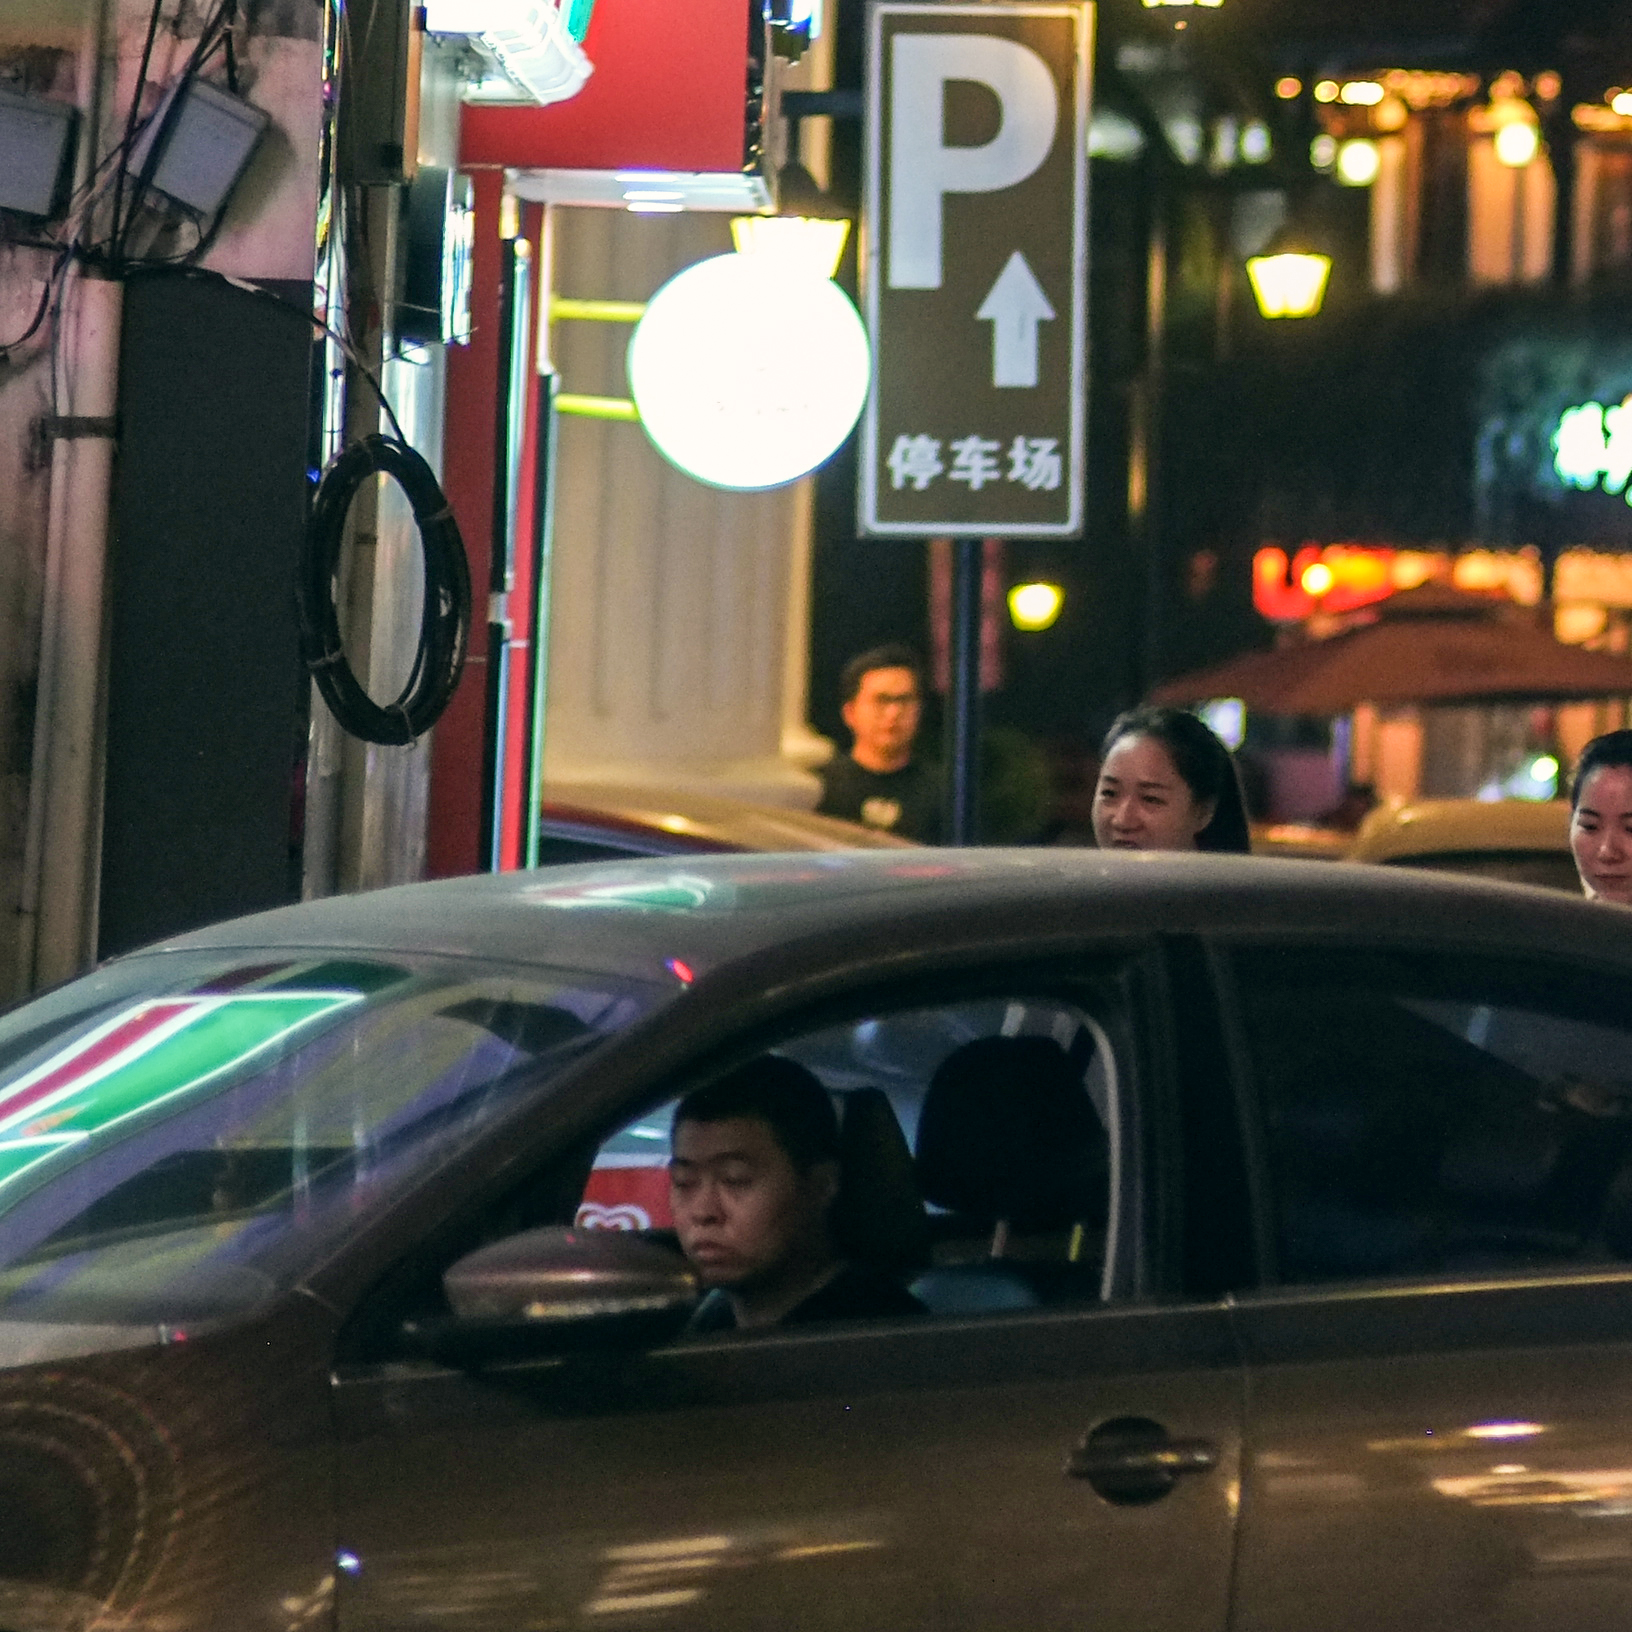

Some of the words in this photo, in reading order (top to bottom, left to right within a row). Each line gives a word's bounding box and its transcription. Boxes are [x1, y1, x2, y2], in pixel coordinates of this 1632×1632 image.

[888, 33, 1060, 290] P
[887, 434, 1063, 491] 停车场
